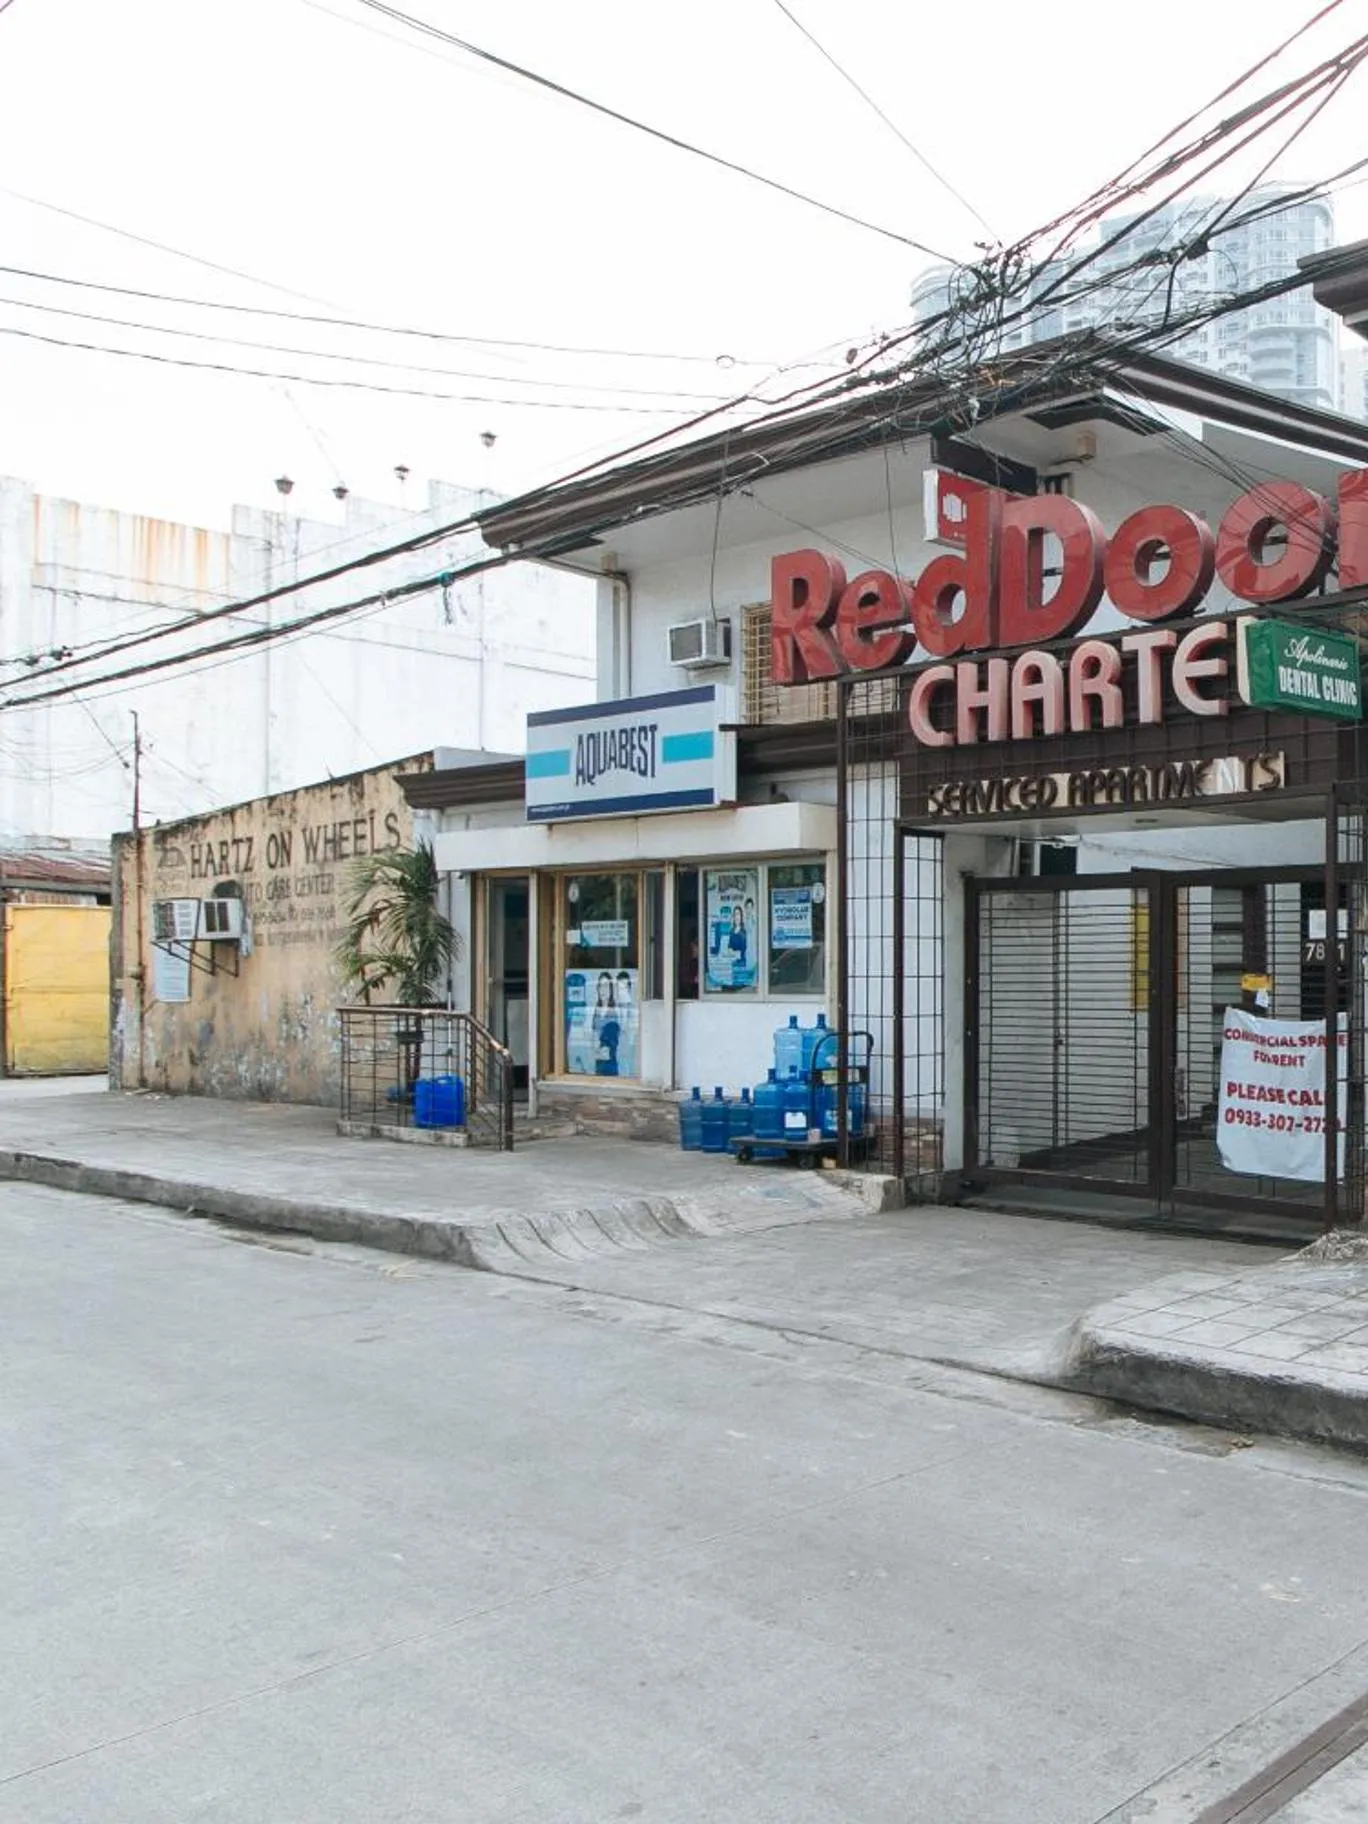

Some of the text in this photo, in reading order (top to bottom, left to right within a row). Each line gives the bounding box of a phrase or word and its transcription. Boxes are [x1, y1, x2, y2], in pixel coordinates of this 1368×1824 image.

[1279, 666, 1357, 706] DENTAL CLINIC
[575, 723, 658, 787] AQUABEST
[189, 812, 401, 879] HARTZ ON WHEELS
[295, 872, 335, 898] CENTER
[1305, 942, 1346, 961] 781
[1298, 1034, 1346, 1048] SPAE
[1227, 1081, 1328, 1106] PLEASE CAL
